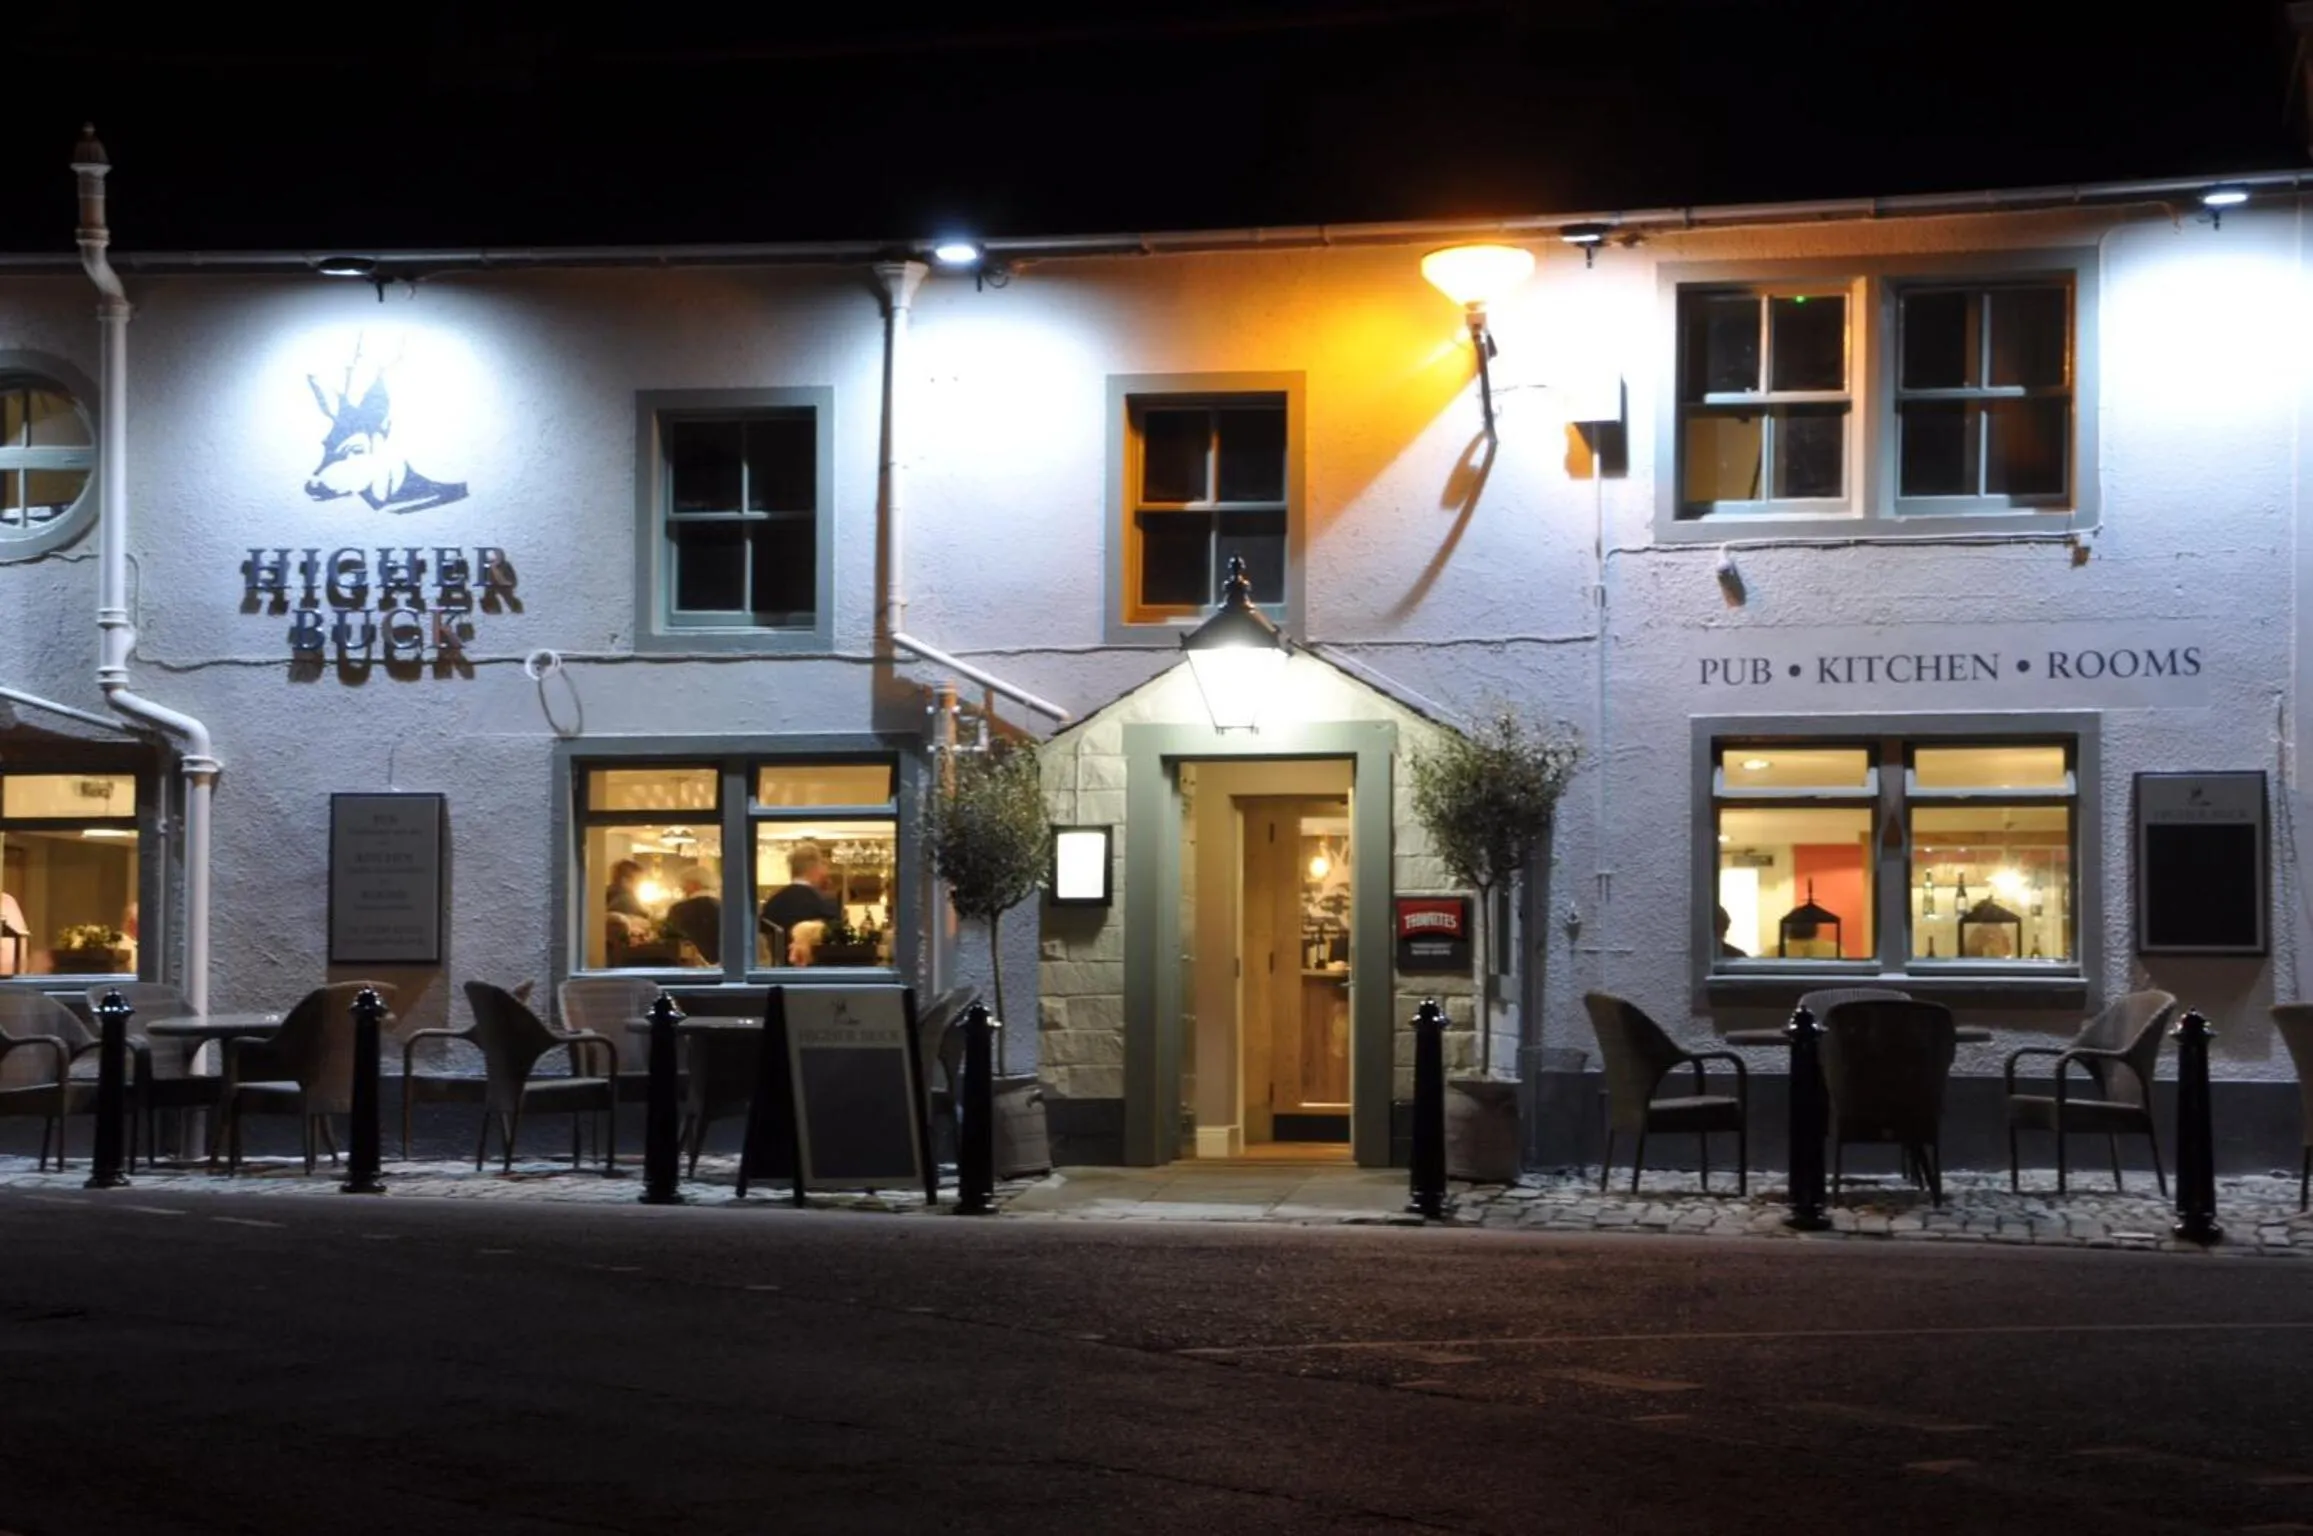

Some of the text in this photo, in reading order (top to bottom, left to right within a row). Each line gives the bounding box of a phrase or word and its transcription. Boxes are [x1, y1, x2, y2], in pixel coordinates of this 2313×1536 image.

[245, 547, 518, 590] HIGHER
[292, 607, 469, 650] BUCK
[1700, 646, 2202, 686] PUB KITCHEN ROOMS
